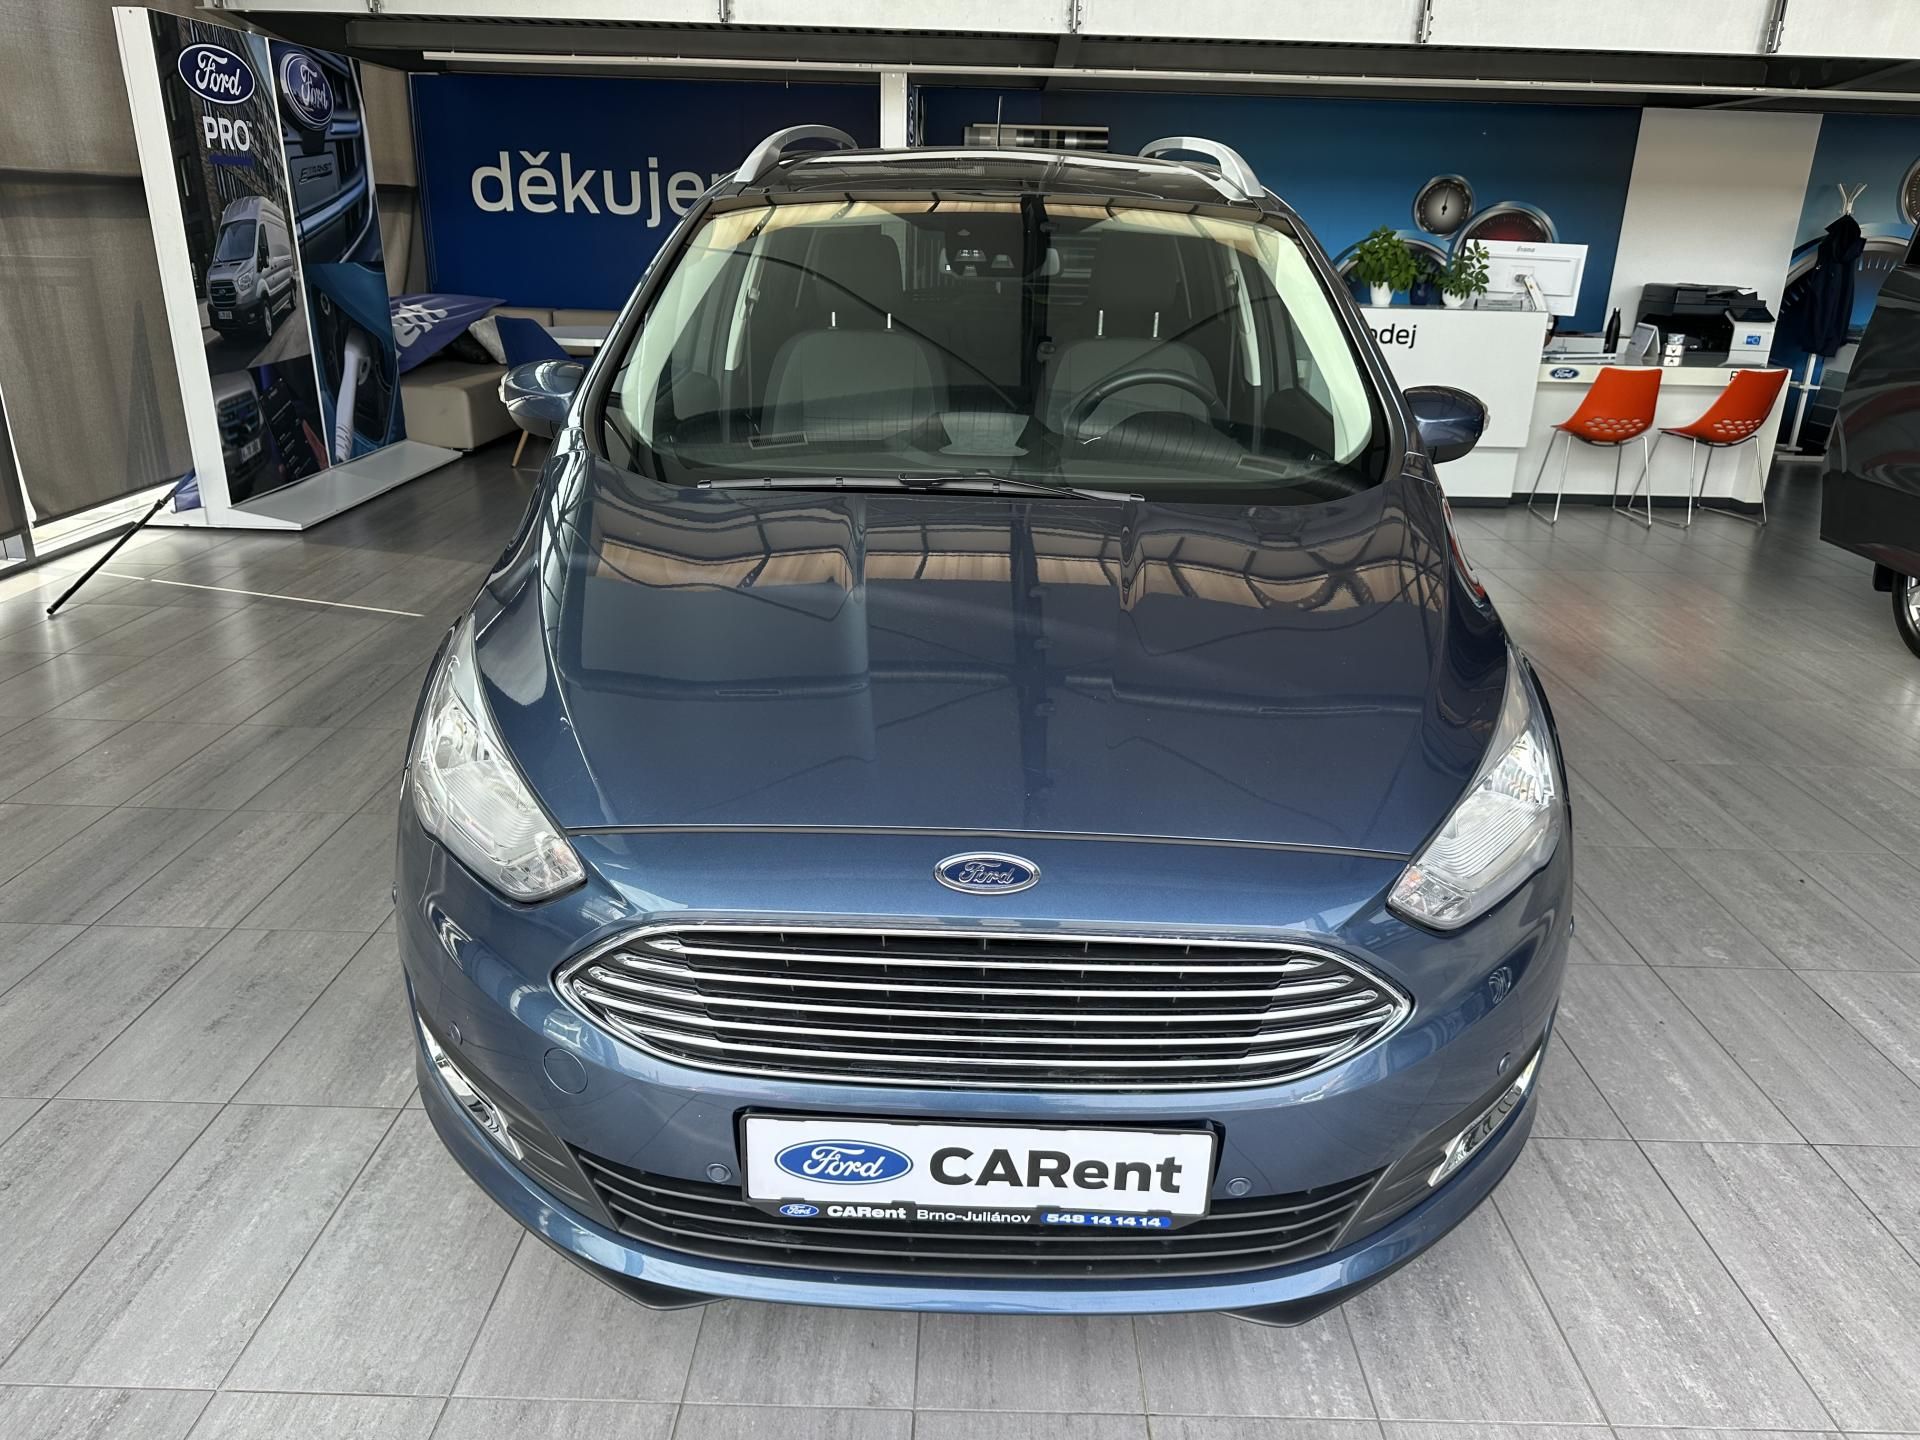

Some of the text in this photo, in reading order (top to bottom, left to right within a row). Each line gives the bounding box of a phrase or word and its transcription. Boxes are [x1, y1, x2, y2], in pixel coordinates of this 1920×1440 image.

[195, 51, 242, 96] Ford
[300, 64, 328, 110] Ford
[471, 150, 733, 227] děkuje
[959, 861, 1015, 884] Ford
[803, 1146, 1182, 1194] Ford CARent
[786, 1204, 1161, 1227] Ford CARent Brno-Juliánov 548 14 14 14
